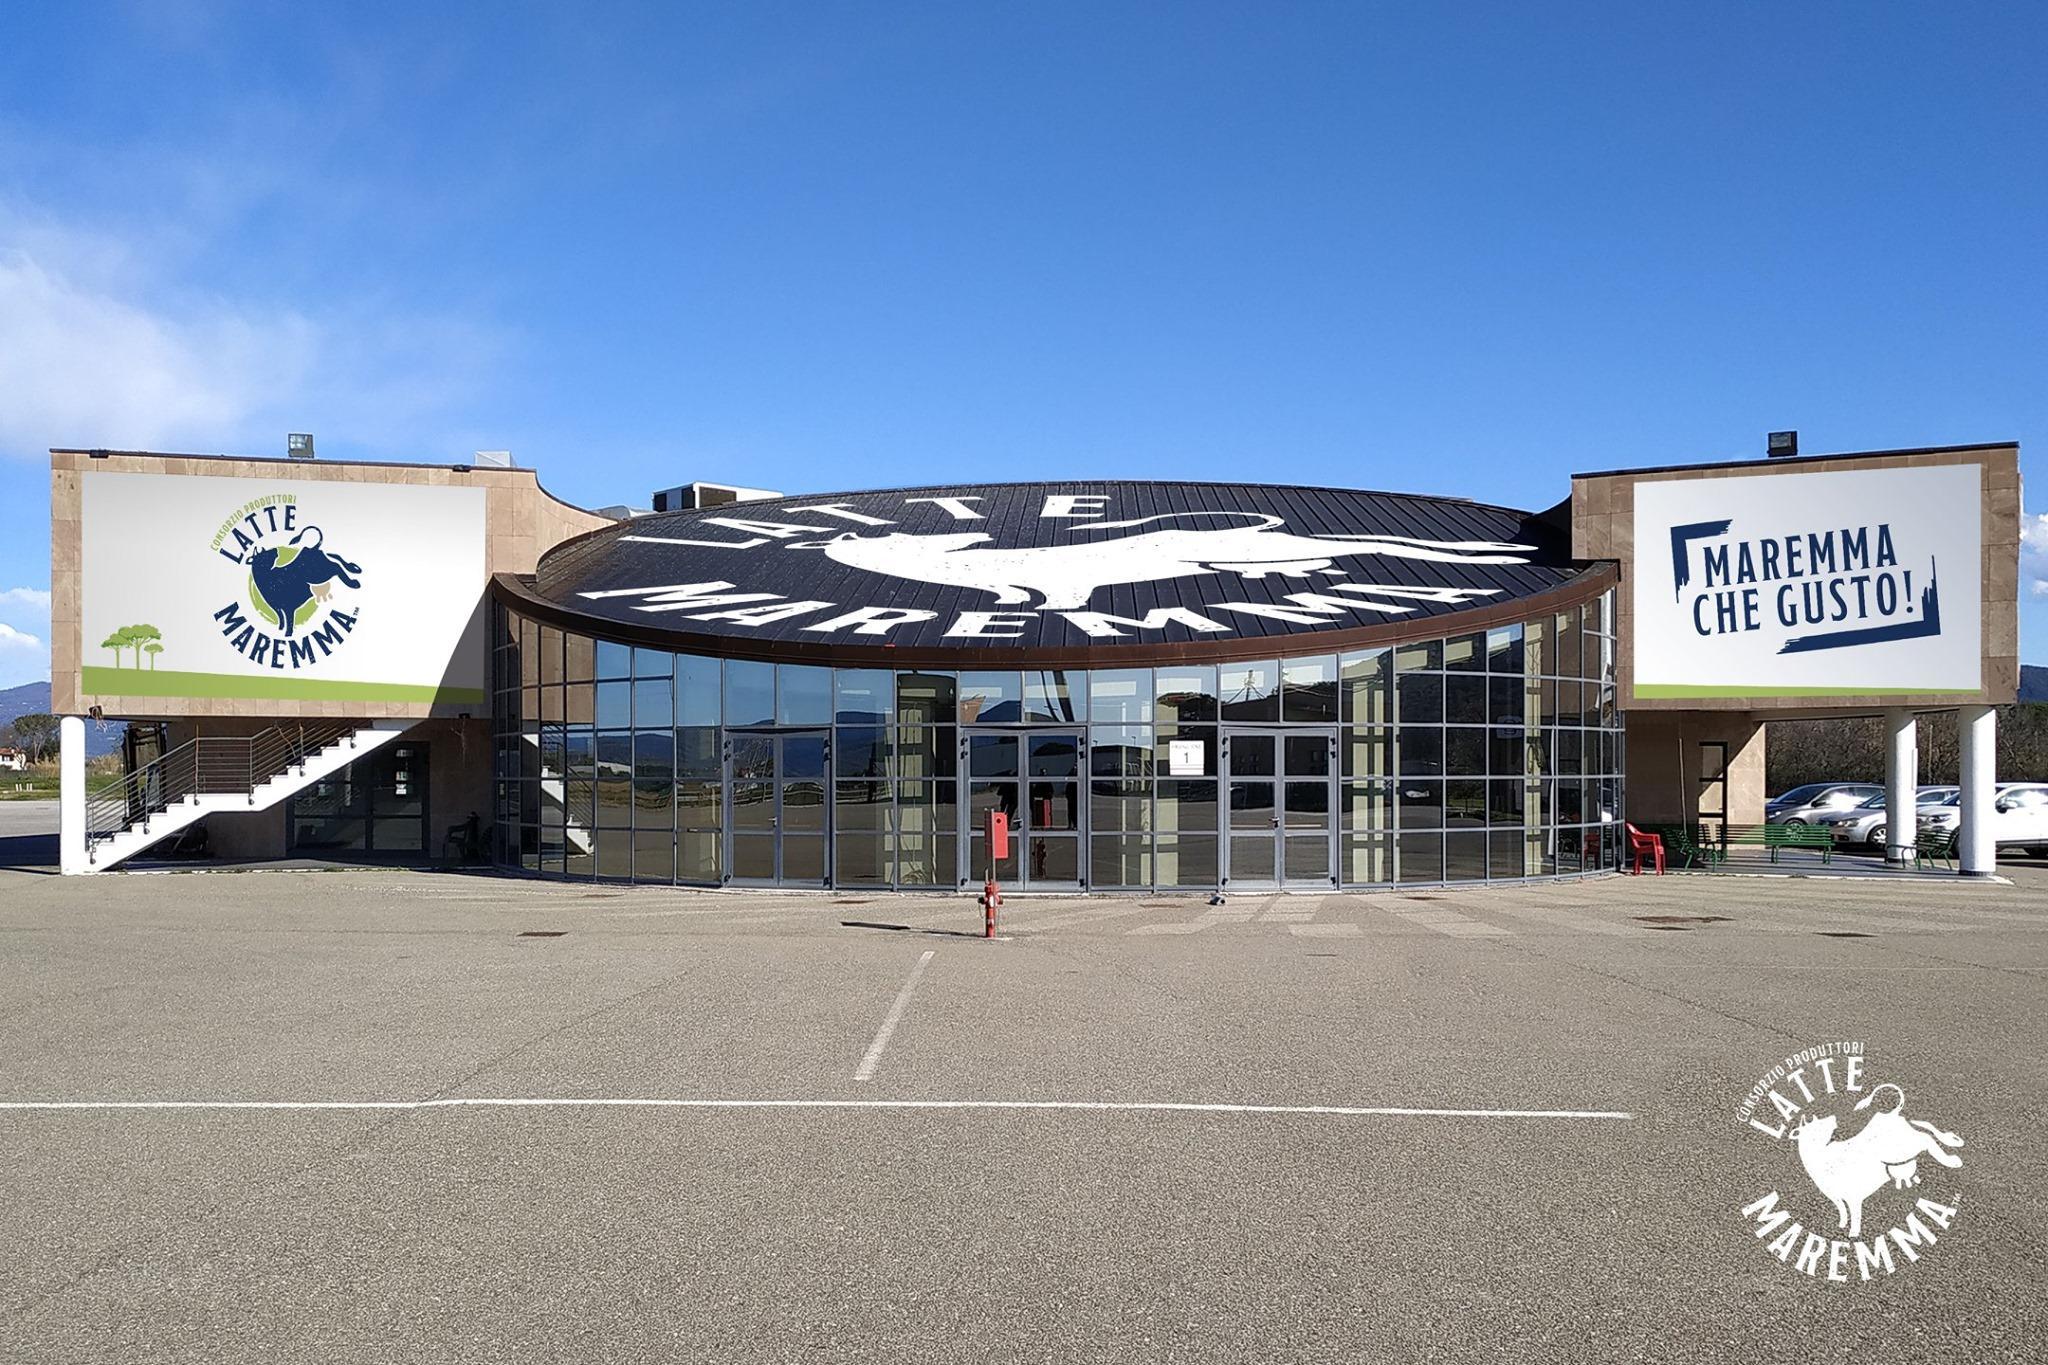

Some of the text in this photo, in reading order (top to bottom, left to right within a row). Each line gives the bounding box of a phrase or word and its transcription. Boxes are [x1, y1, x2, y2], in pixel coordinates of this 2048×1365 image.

[210, 494, 297, 552] CONSORZIO PRODUTTORI
[219, 505, 297, 565] LATTE
[617, 494, 1110, 549] LATTE
[1703, 523, 1898, 588] MAREMMA
[575, 580, 1503, 638] MAREMMA
[1693, 570, 1914, 636] CHE GUSTO!
[213, 601, 357, 669] MAREMMA
[1184, 752, 1189, 764] 1
